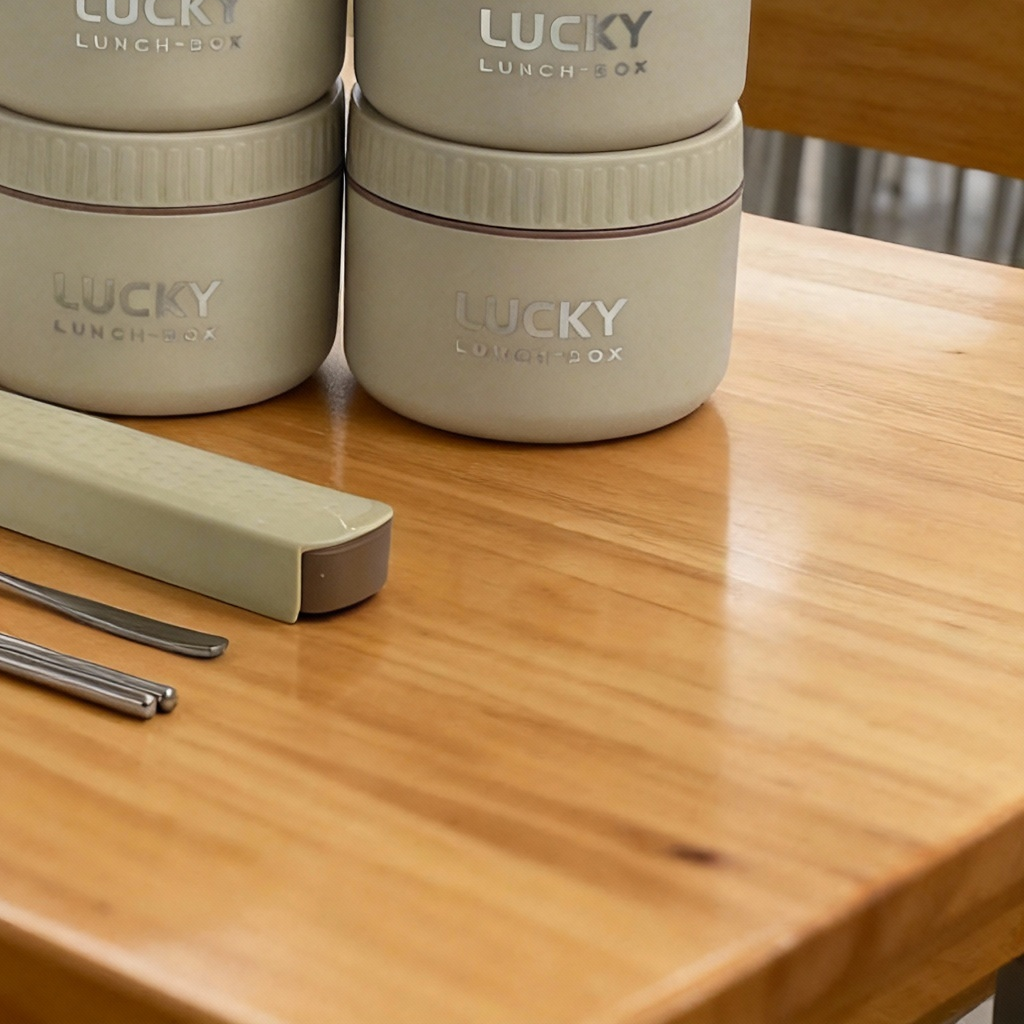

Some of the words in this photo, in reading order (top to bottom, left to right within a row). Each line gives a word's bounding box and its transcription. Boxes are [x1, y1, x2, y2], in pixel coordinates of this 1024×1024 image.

[75, 33, 243, 53] LUNCH-BOX
[480, 8, 652, 52] LUCKY
[479, 58, 648, 79] LUNCH-BOX
[53, 272, 223, 319] LUCKY
[455, 290, 628, 339] LUCKY
